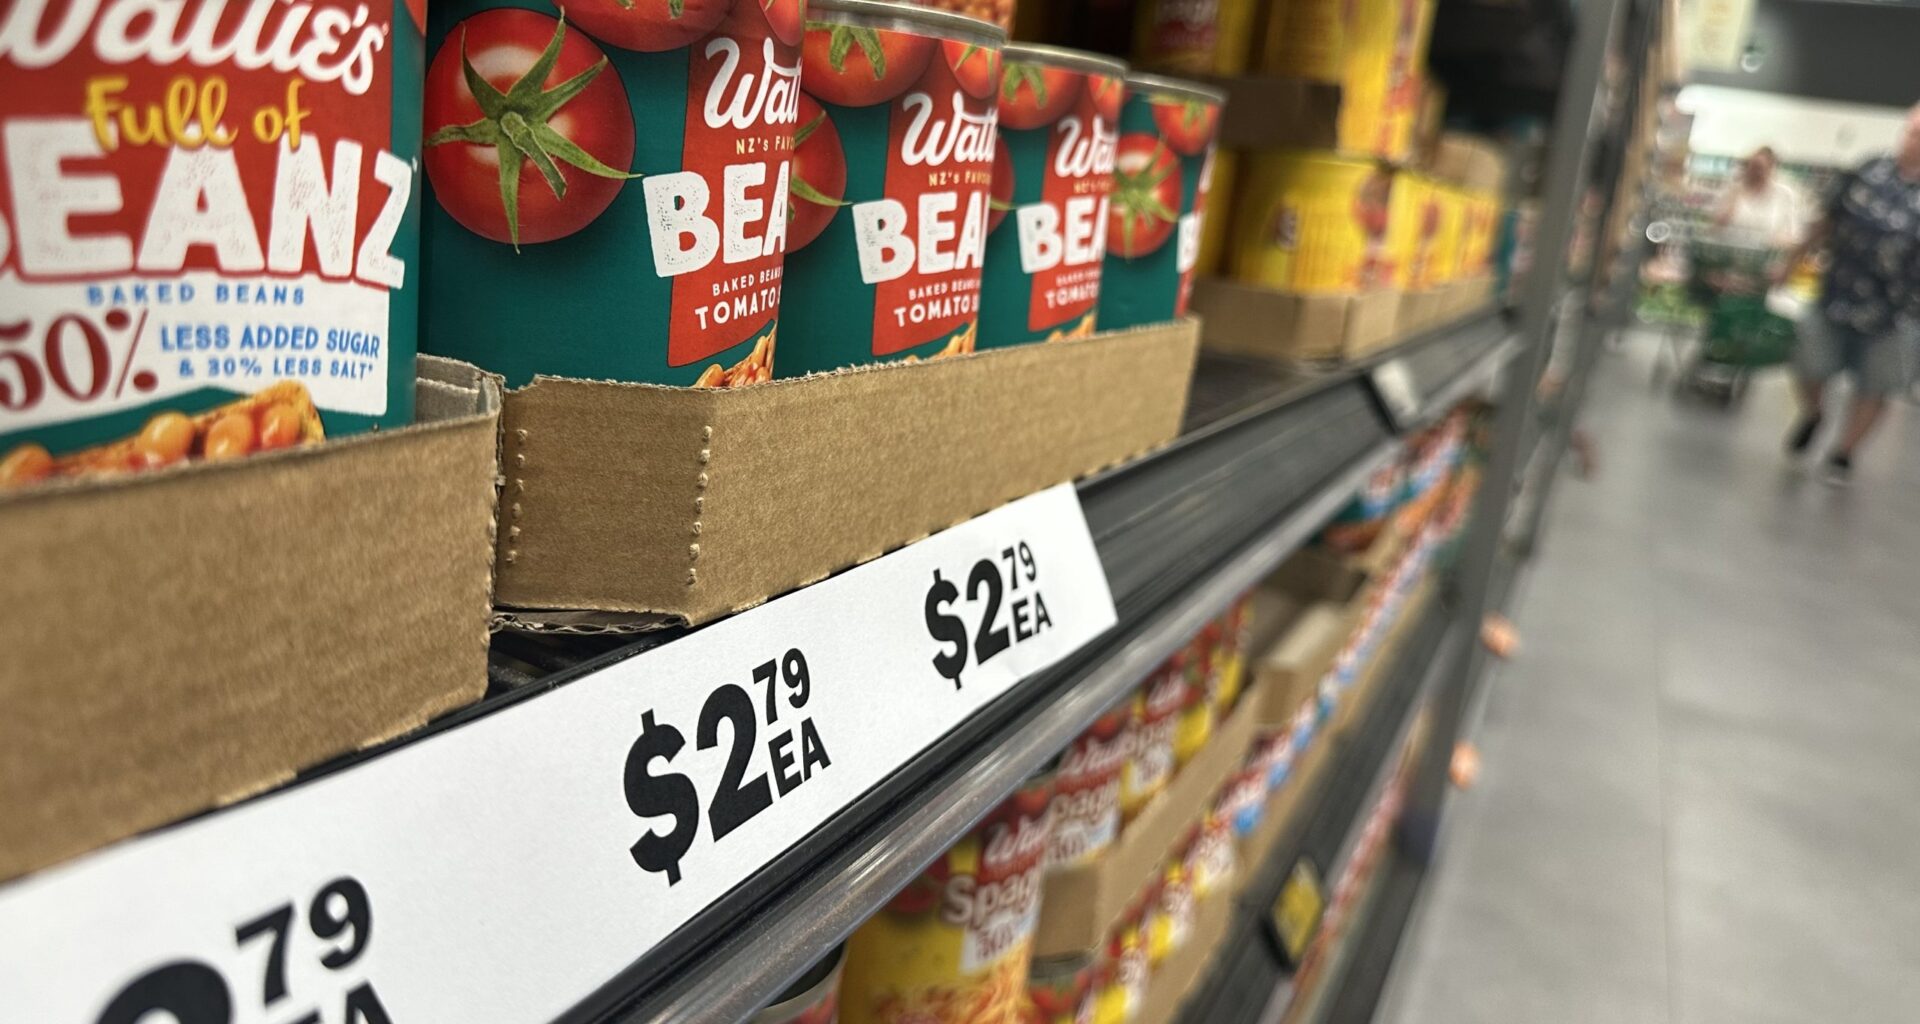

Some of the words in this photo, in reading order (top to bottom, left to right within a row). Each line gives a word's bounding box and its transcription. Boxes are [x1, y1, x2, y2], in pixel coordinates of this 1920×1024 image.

[86, 75, 238, 151] Full
[253, 78, 311, 151] of
[0, 118, 411, 289] EANZ
[852, 191, 990, 284] BEA
[86, 284, 196, 306] BAKED
[215, 284, 306, 306] BEANS
[694, 286, 776, 331] TOMATO
[712, 273, 755, 297] BAKED
[160, 325, 231, 352] LESS
[240, 325, 320, 350] ADDED
[326, 328, 381, 359] SUGAR
[179, 358, 195, 379] &
[207, 357, 263, 379] 30%
[273, 357, 322, 377] LESS
[1002, 540, 1037, 591] 79
[1011, 592, 1053, 643] EA
[752, 648, 811, 727] 79
[768, 716, 832, 798] EA
[235, 876, 373, 1009] 79
